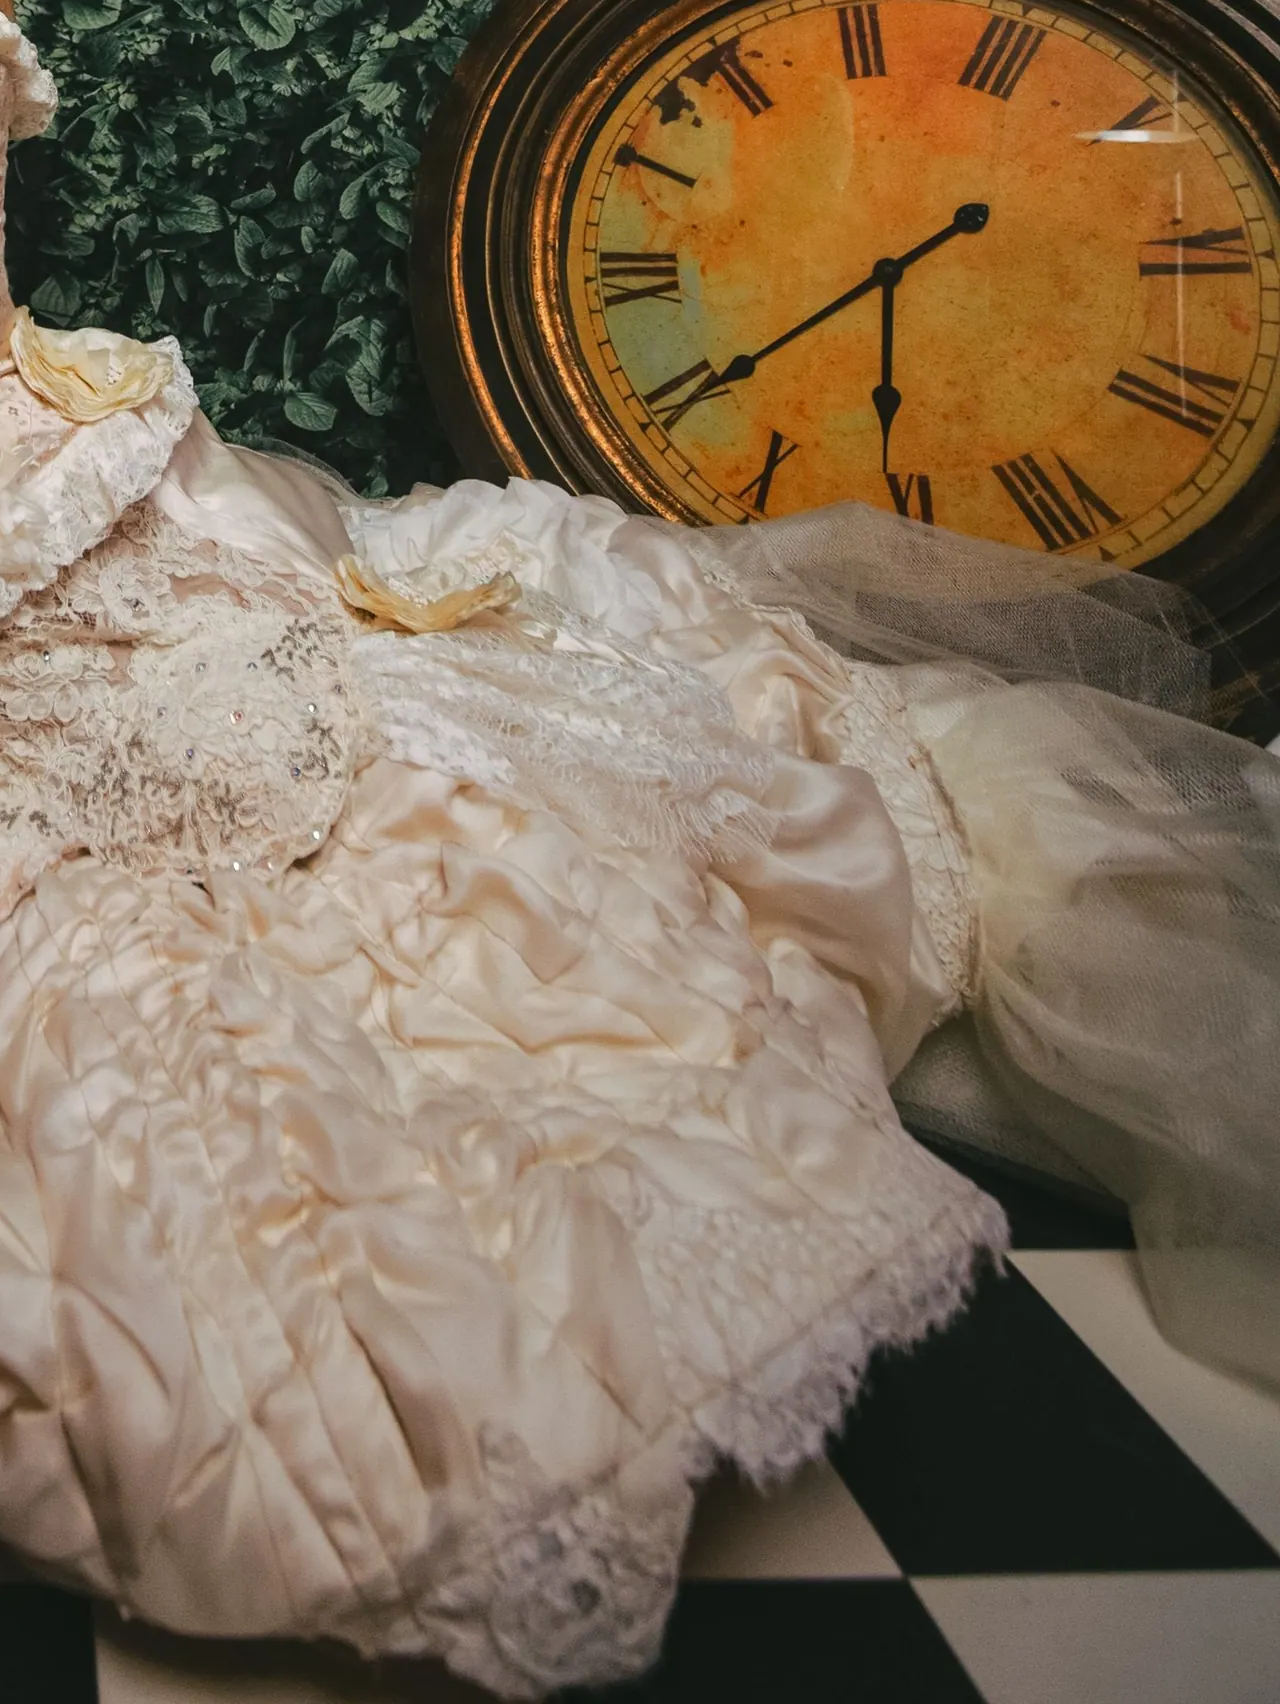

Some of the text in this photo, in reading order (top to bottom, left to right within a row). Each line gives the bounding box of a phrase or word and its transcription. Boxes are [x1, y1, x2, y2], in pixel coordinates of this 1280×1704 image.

[837, 2, 888, 81] III
[958, 15, 1048, 101] IIII
[598, 251, 683, 312] XII
[1138, 225, 1253, 278] VI
[1106, 352, 1243, 438] VII
[738, 426, 803, 517] X
[990, 449, 1125, 553] VIII
